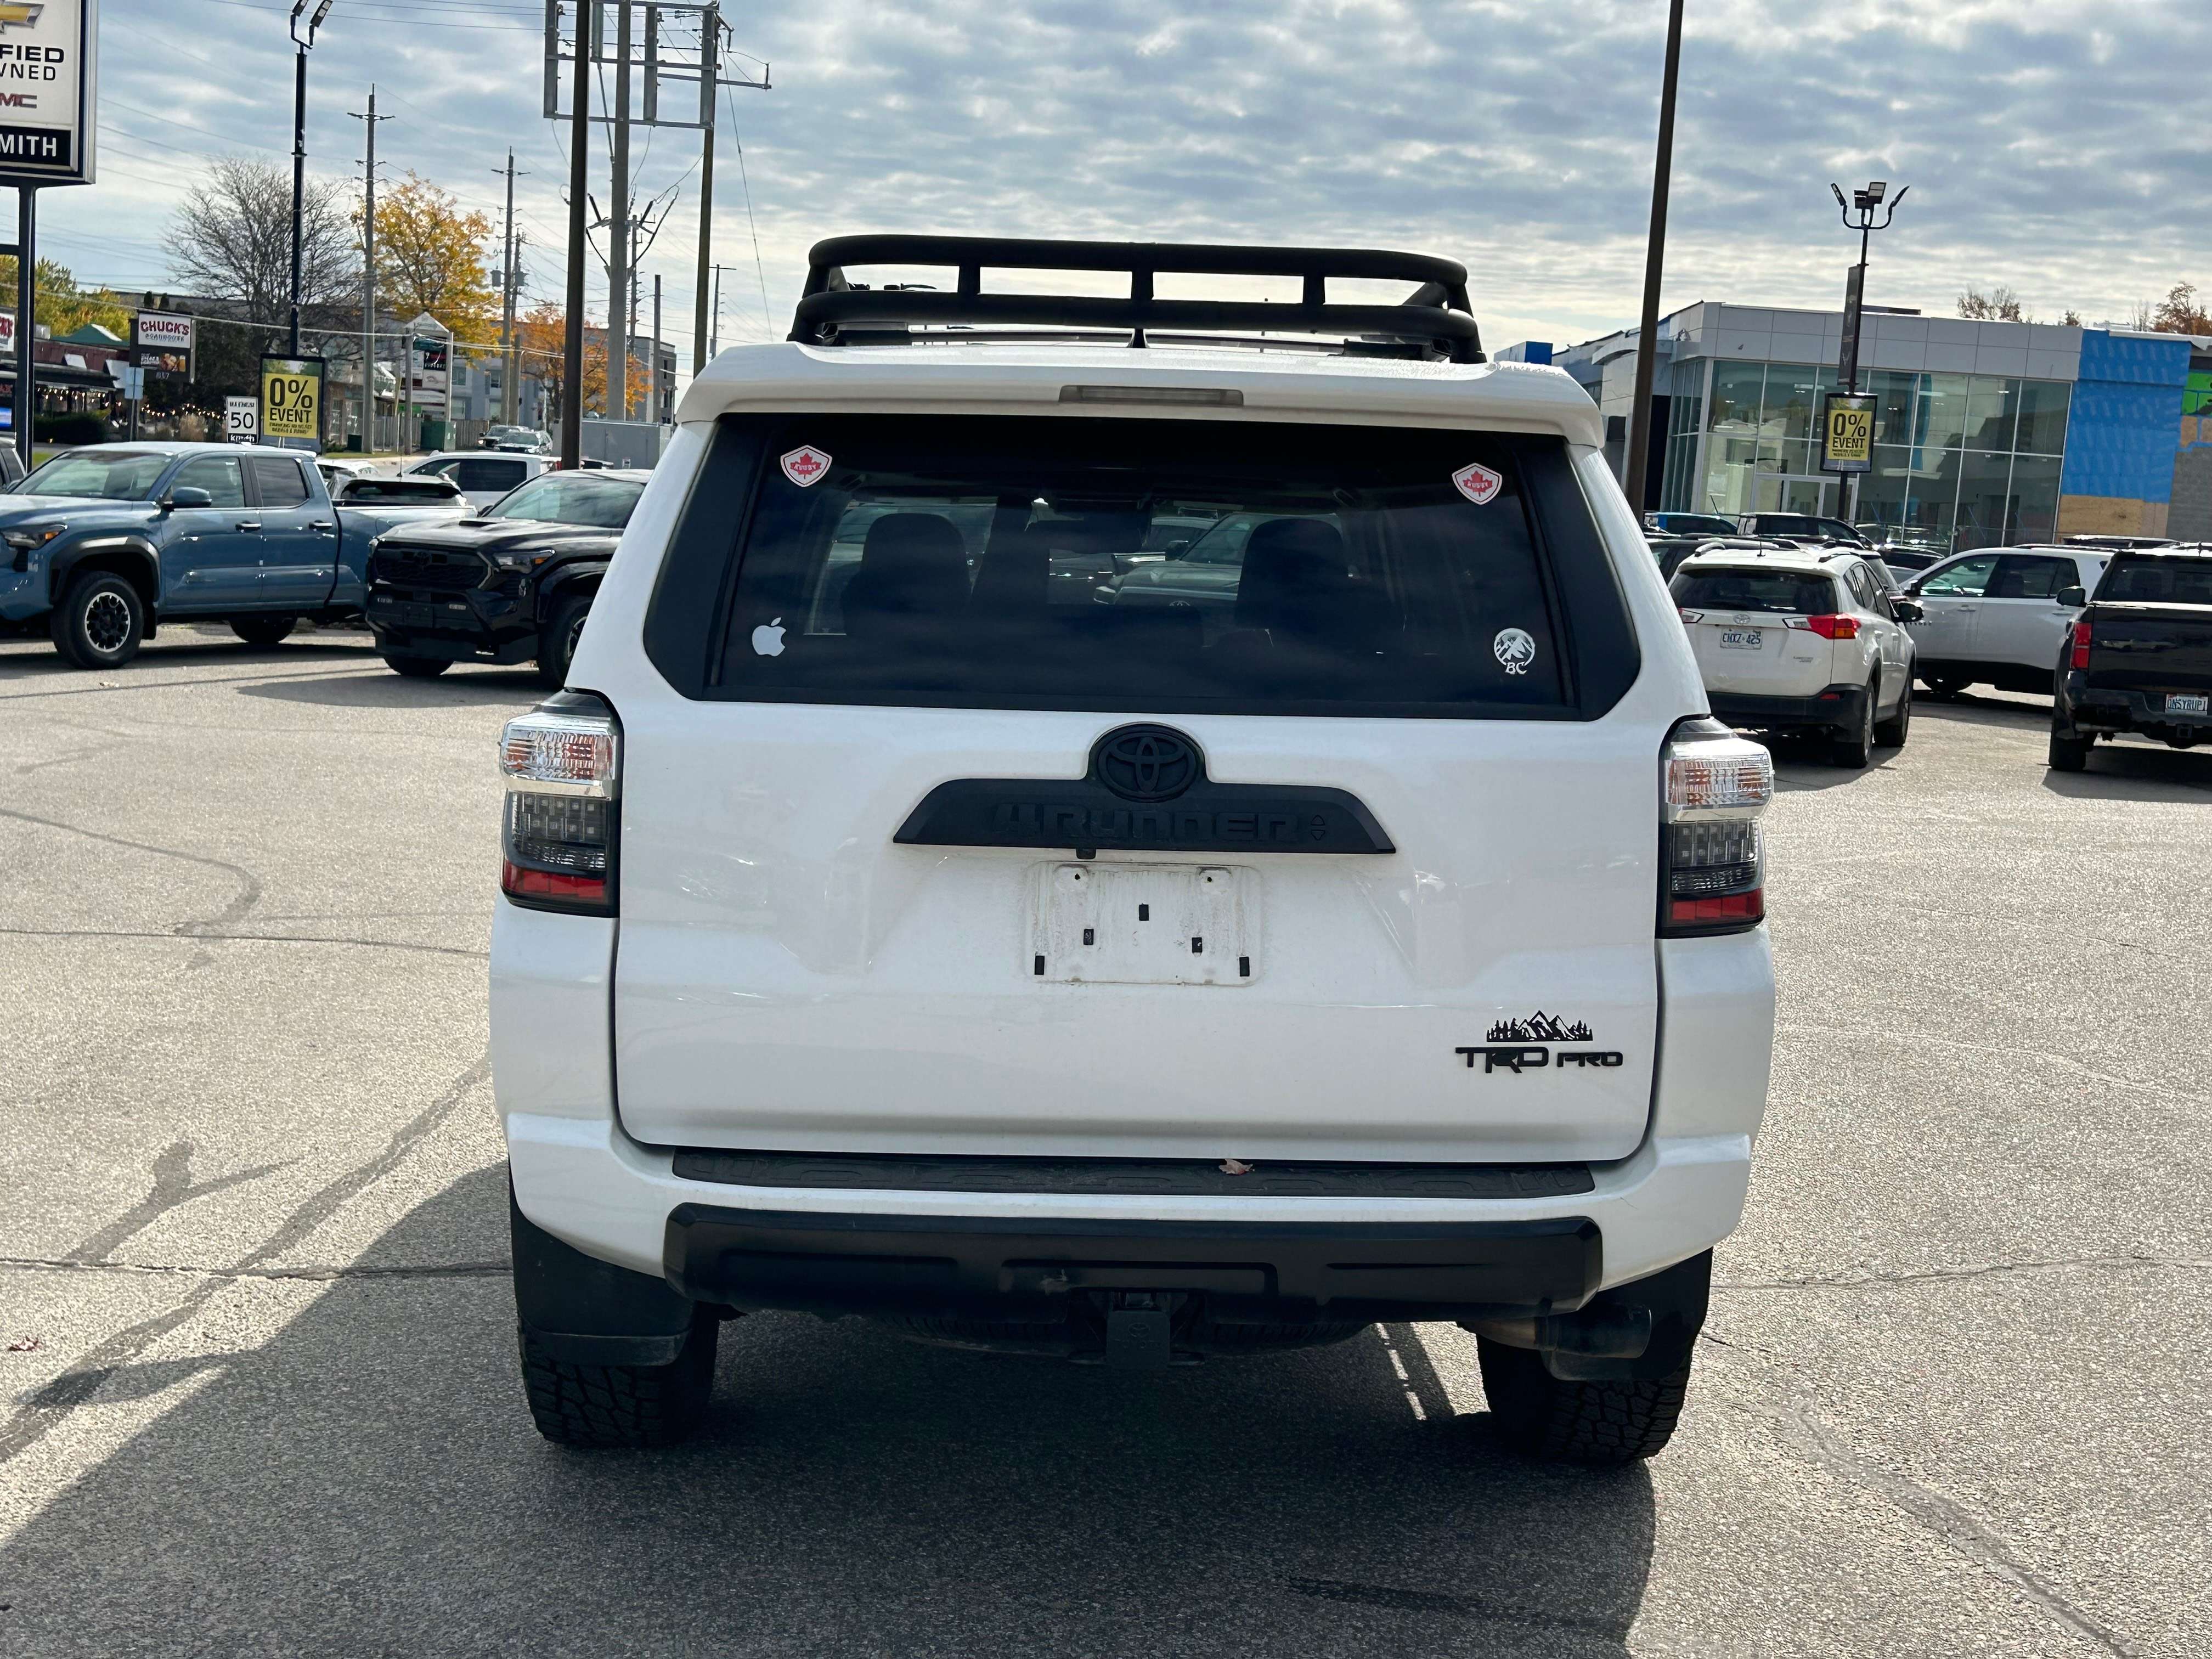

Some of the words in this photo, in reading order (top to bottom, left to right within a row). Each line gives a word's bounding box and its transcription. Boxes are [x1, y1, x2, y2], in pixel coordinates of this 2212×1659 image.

[140, 320, 189, 335] CHUCK'S
[269, 377, 313, 409] 0%
[231, 412, 254, 429] 50
[269, 408, 312, 423] EVENT
[1833, 413, 1866, 437] 0%
[1832, 437, 1865, 448] EVENT
[1505, 662, 1527, 675] BC
[993, 803, 1300, 842] 4RUNNER
[1455, 1047, 1549, 1074] TRD
[1557, 1051, 1623, 1068] PRO
